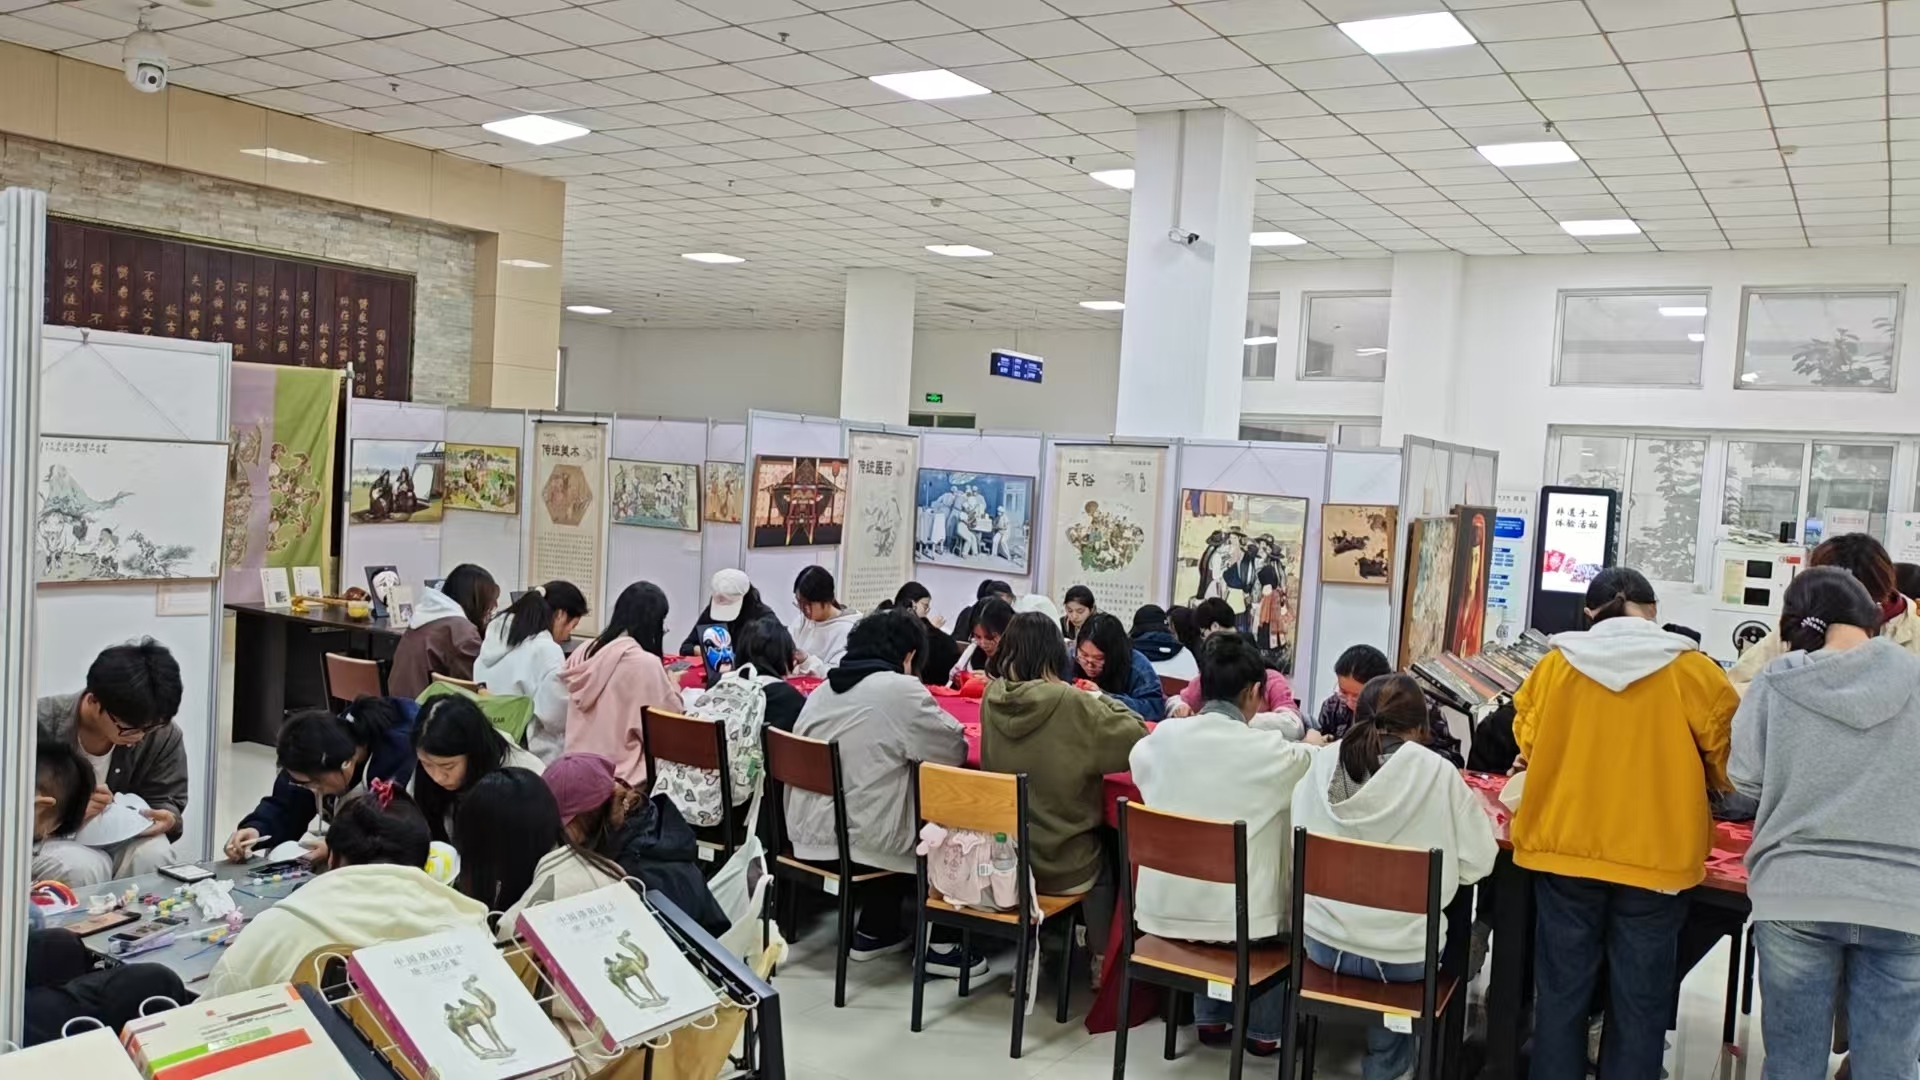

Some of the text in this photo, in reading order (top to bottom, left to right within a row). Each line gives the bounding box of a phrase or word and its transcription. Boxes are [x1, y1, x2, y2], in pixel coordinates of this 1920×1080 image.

[541, 443, 581, 458] 传统美术
[857, 459, 894, 477] 传统医药
[1066, 471, 1096, 488] 民俗
[1555, 506, 1600, 518] 非遗手工
[1554, 518, 1599, 530] 体验活动
